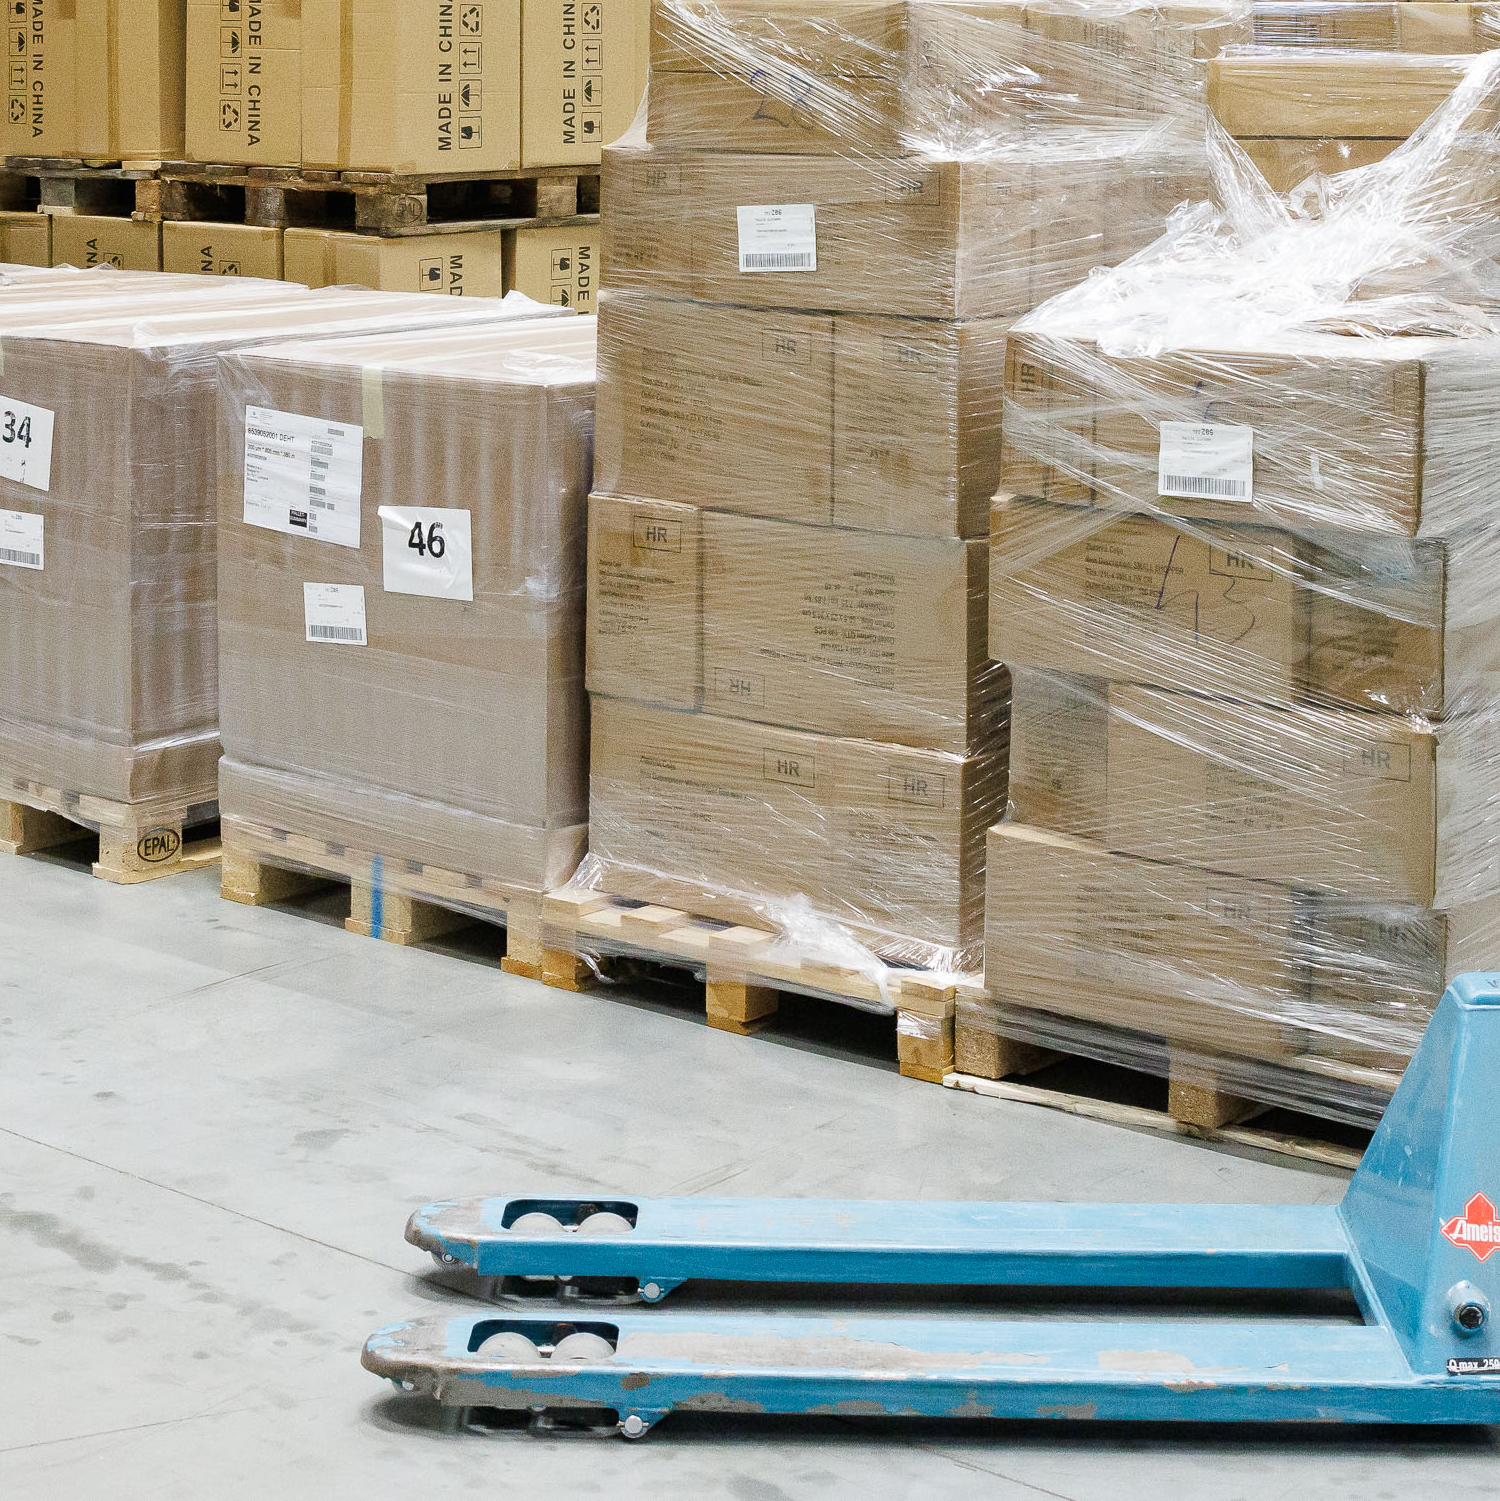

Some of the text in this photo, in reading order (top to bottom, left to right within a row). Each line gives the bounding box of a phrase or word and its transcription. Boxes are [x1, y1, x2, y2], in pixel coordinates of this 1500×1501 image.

[32, 54, 43, 71] IN
[248, 57, 261, 75] IN
[563, 61, 575, 79] IN
[438, 64, 452, 83] IN
[32, 81, 43, 138] CHINA
[248, 85, 261, 146] CHINA
[563, 89, 575, 144] MADE
[438, 94, 452, 151] MADE
[577, 246, 591, 302] MADE
[775, 338, 798, 357] HR
[897, 346, 923, 364] HR
[1017, 361, 1035, 394] HR
[2, 410, 32, 449] 34
[279, 433, 295, 444] DEHT
[407, 521, 445, 559] 46
[645, 524, 668, 545] HR
[1225, 552, 1255, 571] HR
[728, 677, 752, 695] HR
[775, 759, 801, 779] HR
[1360, 749, 1392, 769] HR
[902, 777, 929, 798] HR
[141, 835, 176, 861] EPAL
